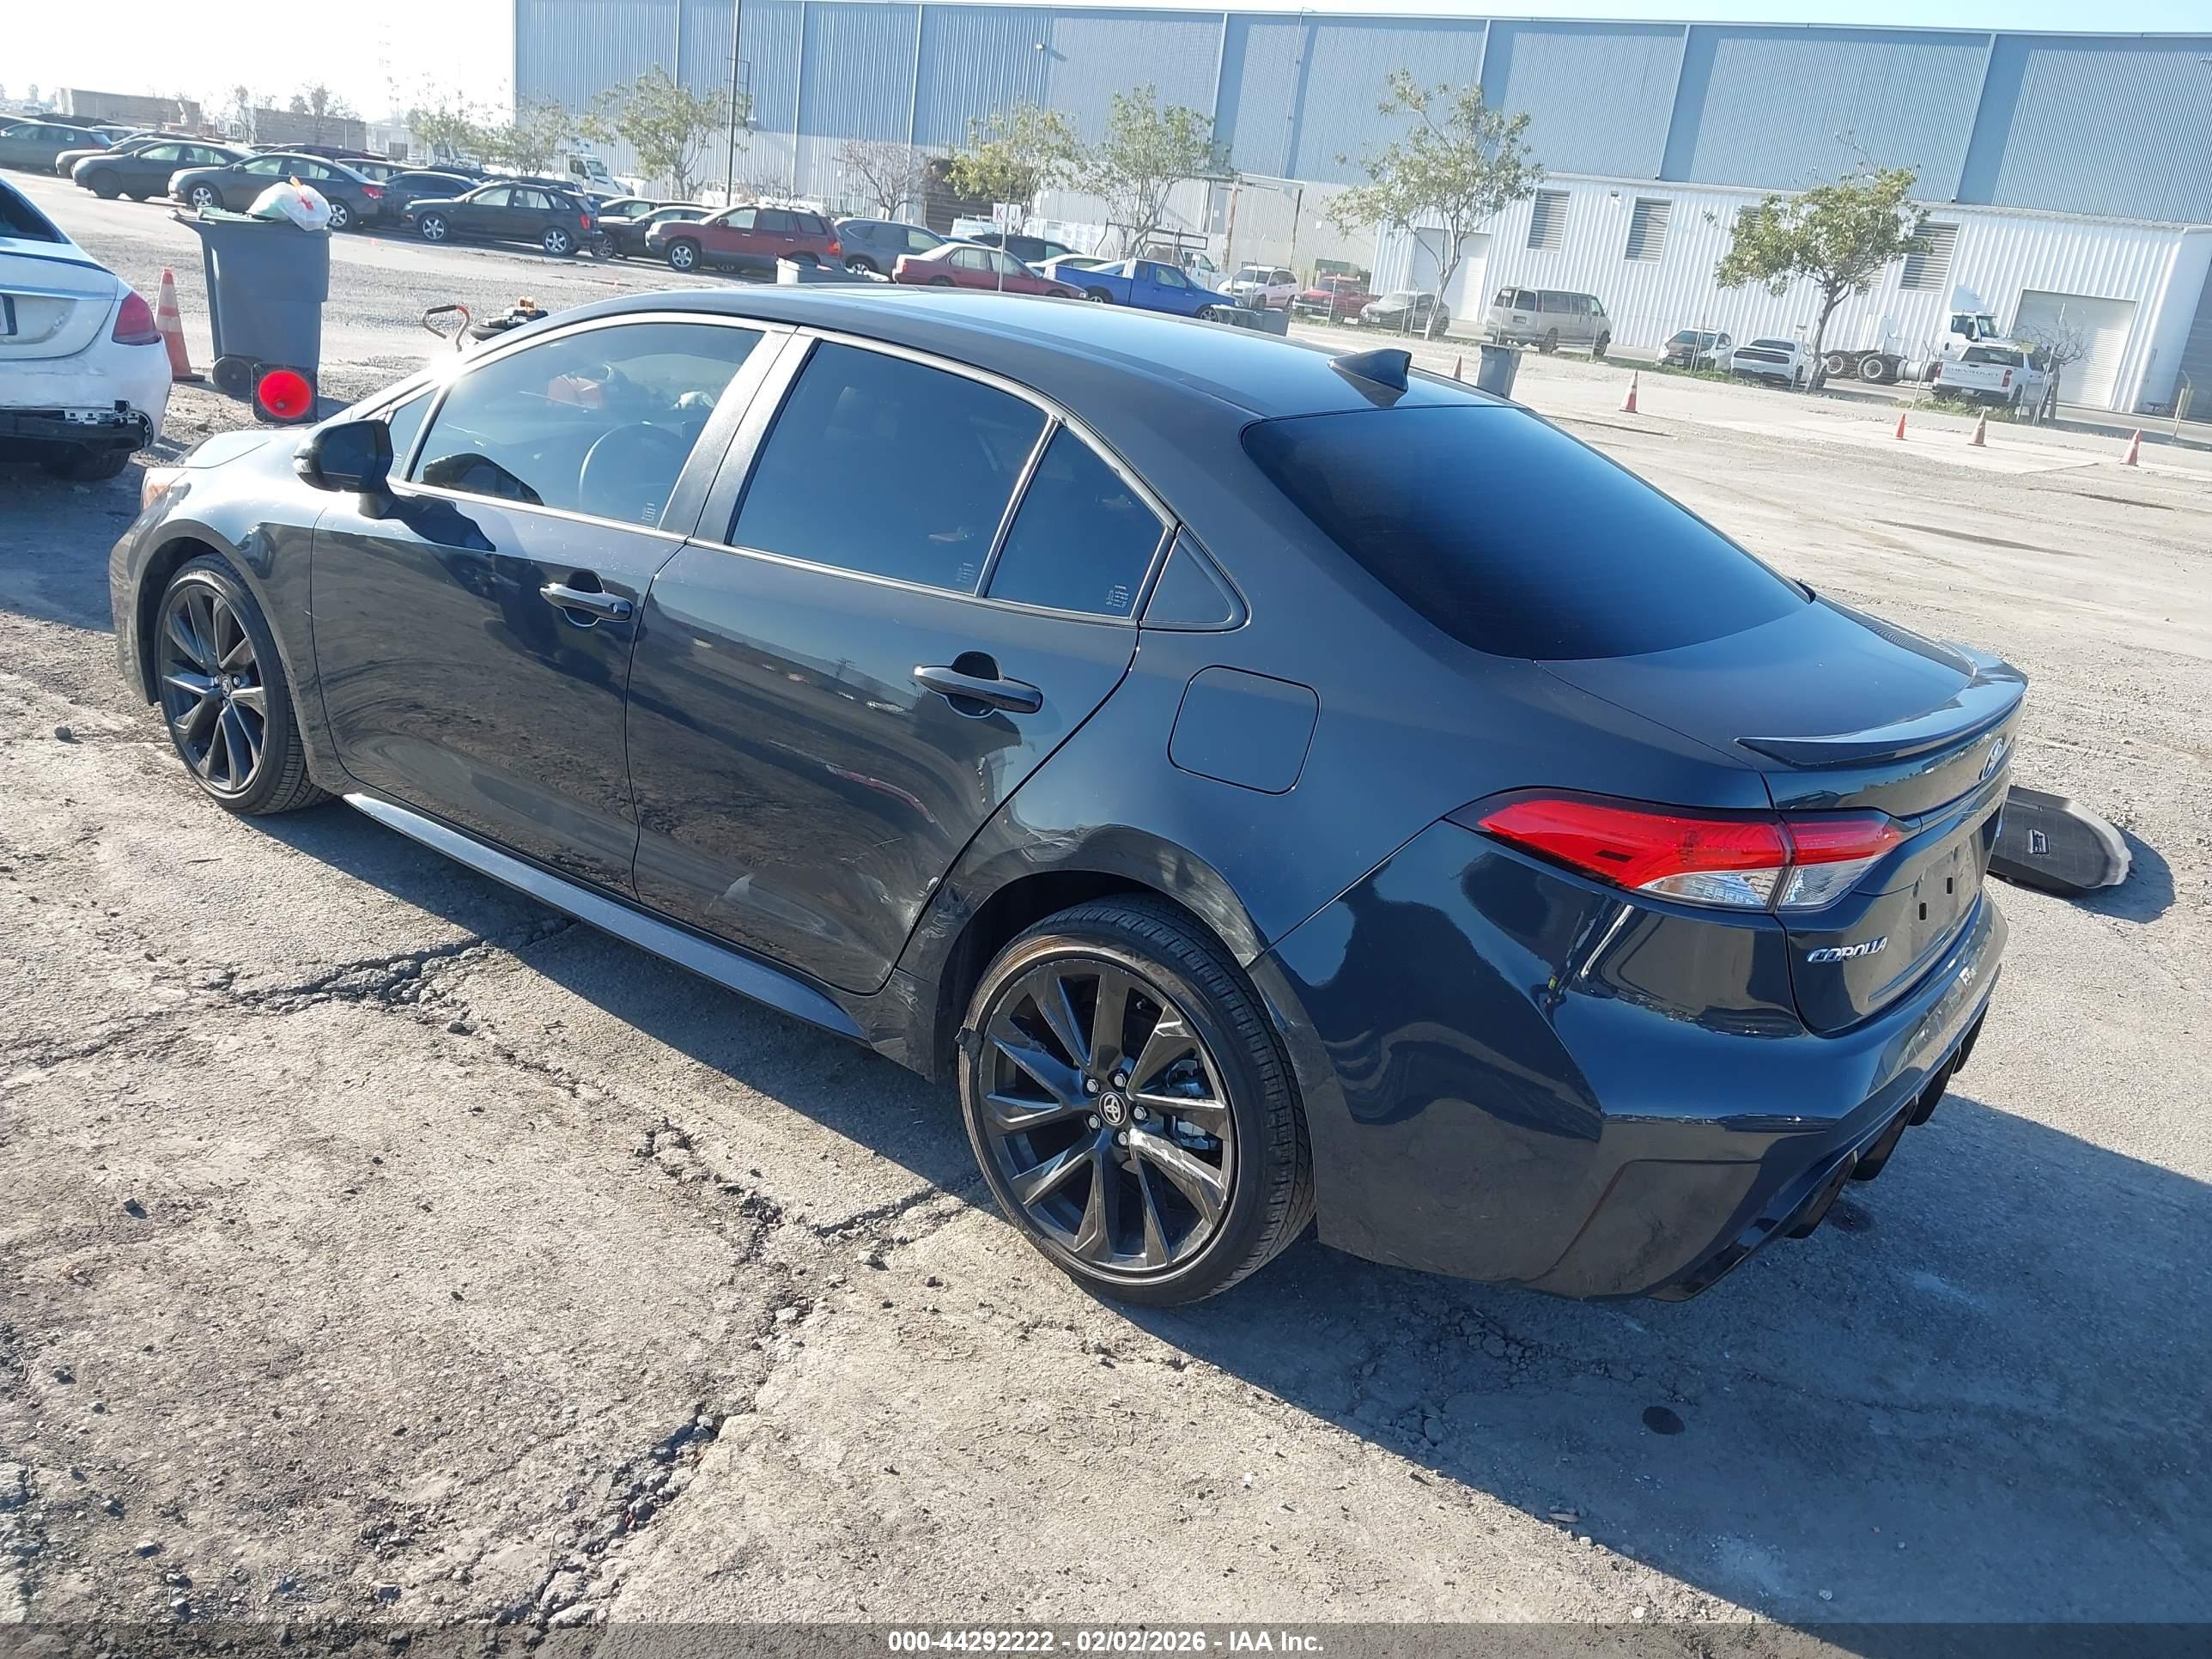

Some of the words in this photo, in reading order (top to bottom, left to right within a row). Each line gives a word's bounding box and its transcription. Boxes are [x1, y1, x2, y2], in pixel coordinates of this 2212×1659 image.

[996, 206, 1004, 221] K
[1011, 208, 1018, 221] J
[1807, 936, 1888, 963] COROLLA
